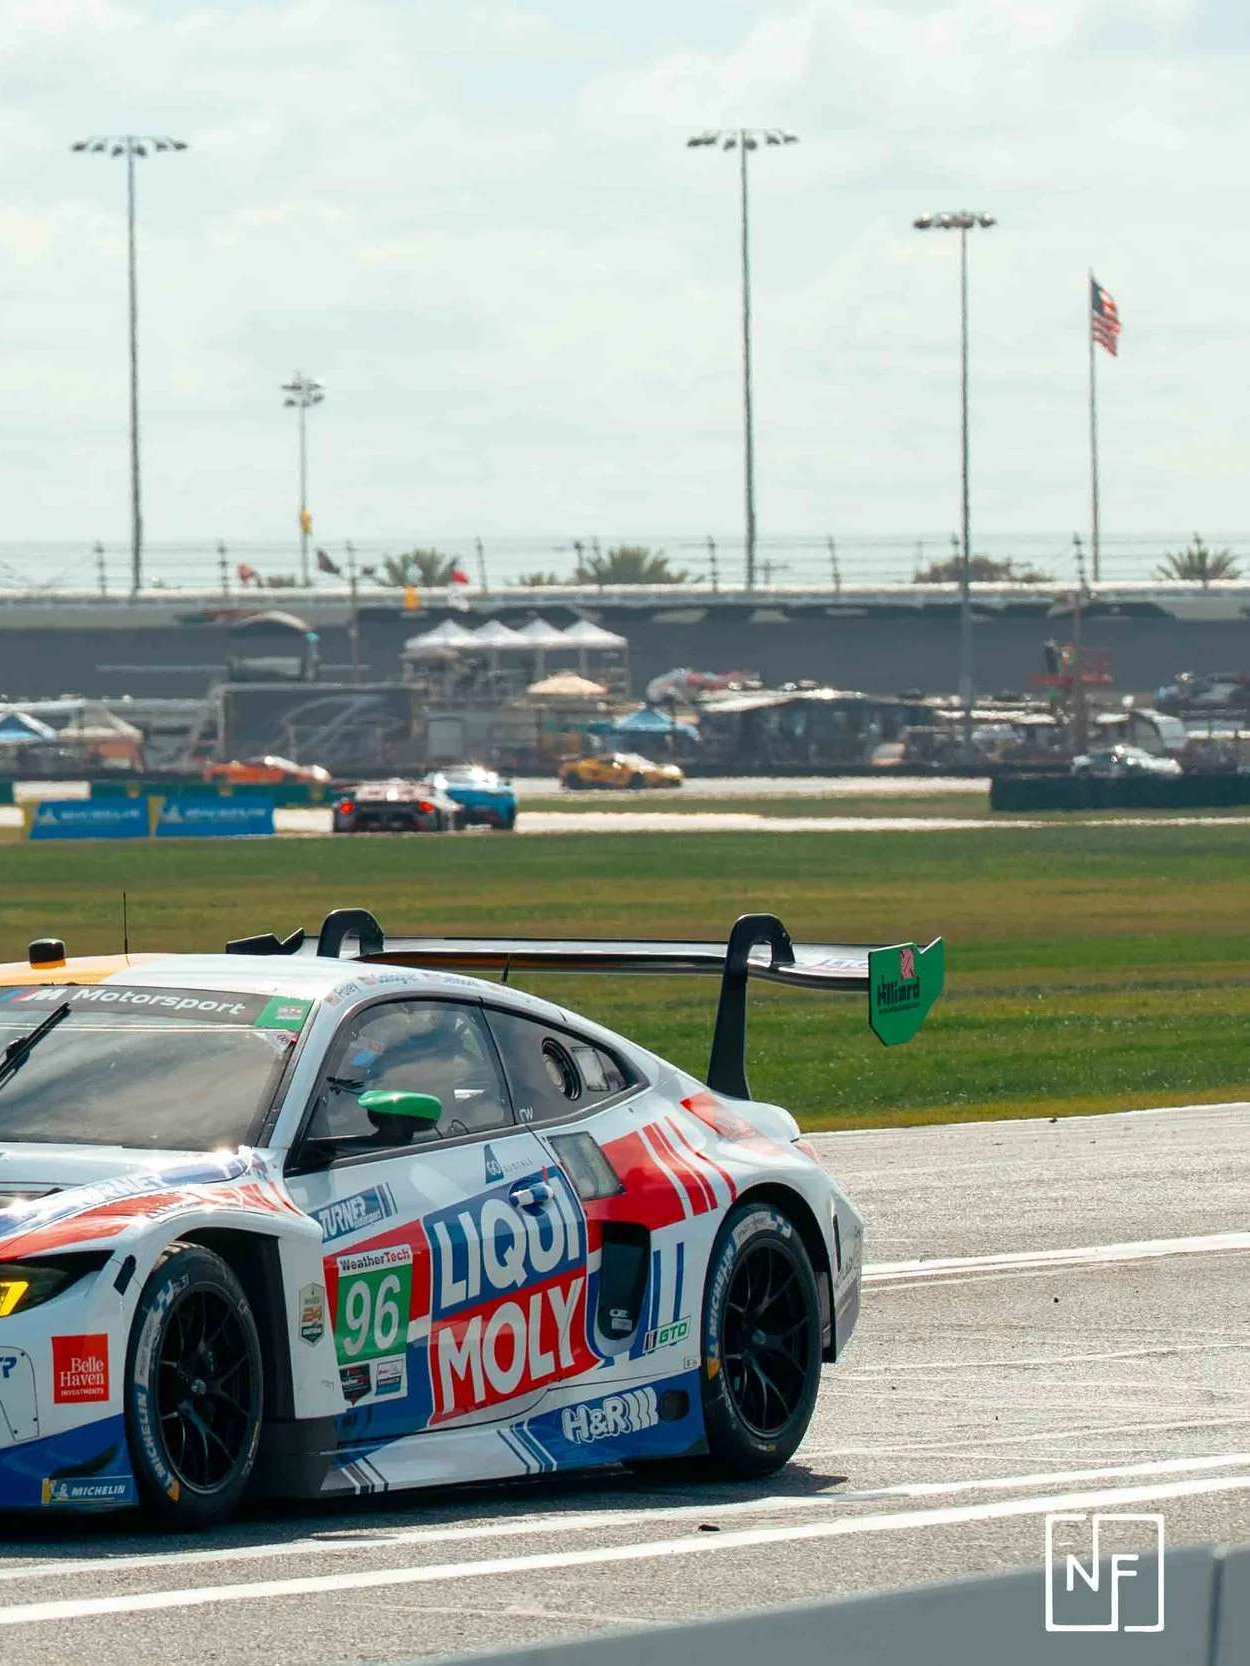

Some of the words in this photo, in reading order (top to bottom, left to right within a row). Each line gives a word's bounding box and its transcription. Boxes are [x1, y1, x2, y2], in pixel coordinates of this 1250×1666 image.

[70, 987, 247, 1015] Motorsport
[318, 1195, 367, 1239] TURNER
[432, 1174, 580, 1310] LIQUI
[339, 1248, 411, 1272] WeatherTech
[343, 1273, 402, 1357] 96
[437, 1275, 586, 1415] MOLY
[658, 1322, 688, 1344] GTD
[70, 1356, 104, 1373] Belle
[59, 1371, 104, 1387] Haven
[561, 1396, 632, 1444] H&R
[71, 1485, 126, 1496] MICHELIN
